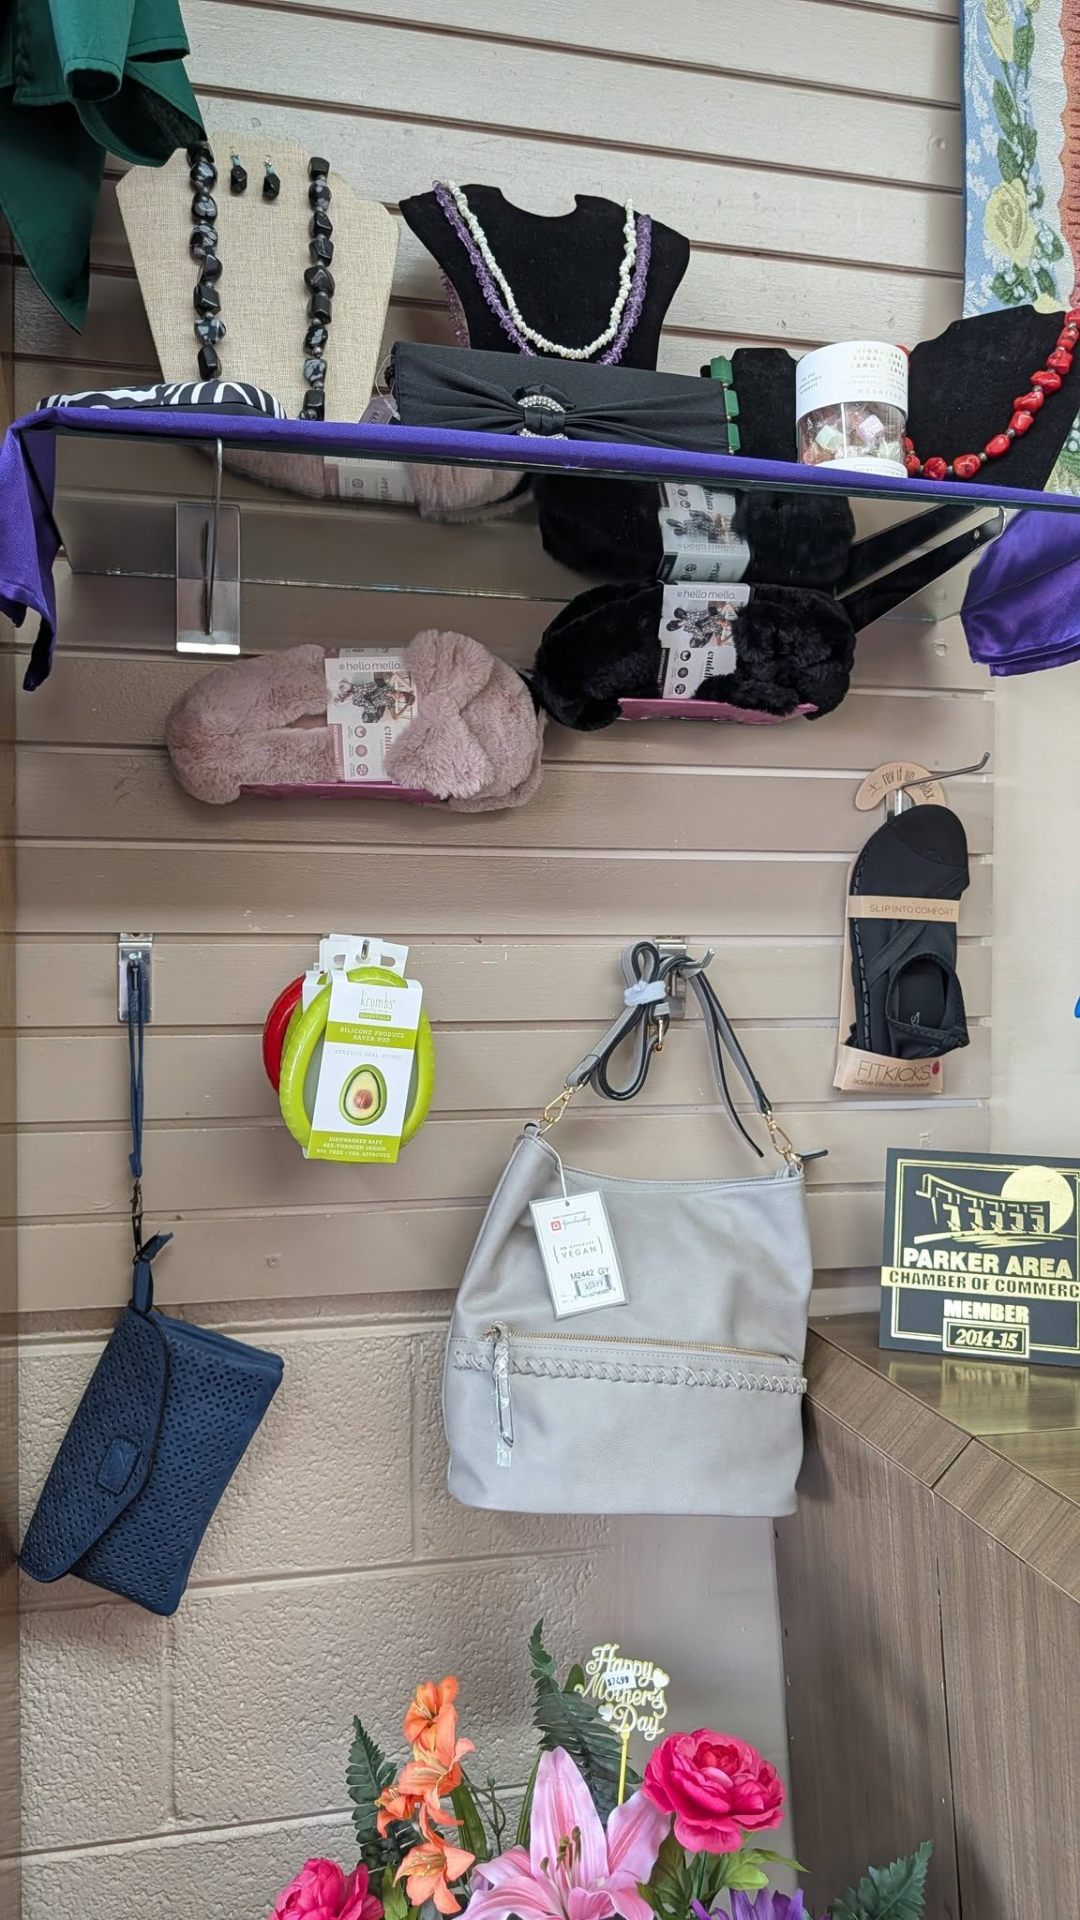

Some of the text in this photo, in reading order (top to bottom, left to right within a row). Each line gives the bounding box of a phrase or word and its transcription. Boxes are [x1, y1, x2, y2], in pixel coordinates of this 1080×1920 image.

[683, 589, 707, 599] hello
[345, 661, 371, 671] hello
[704, 650, 715, 679] cuddl
[869, 904, 954, 915] SLIP INTO COMFORT
[360, 989, 393, 1010] krumbs
[340, 1026, 406, 1039] SILICONE PRODUCE
[561, 1245, 597, 1259] VEGAN
[570, 1266, 610, 1280] M2442 GY
[903, 1247, 1074, 1280] PARKER AREA
[889, 1269, 1080, 1299] CHAMBER OF COMMERC
[943, 1299, 1030, 1324] MEMBER
[954, 1328, 1019, 1349] 2014-15
[585, 1643, 655, 1688] Happy
[608, 1703, 666, 1741] Day
